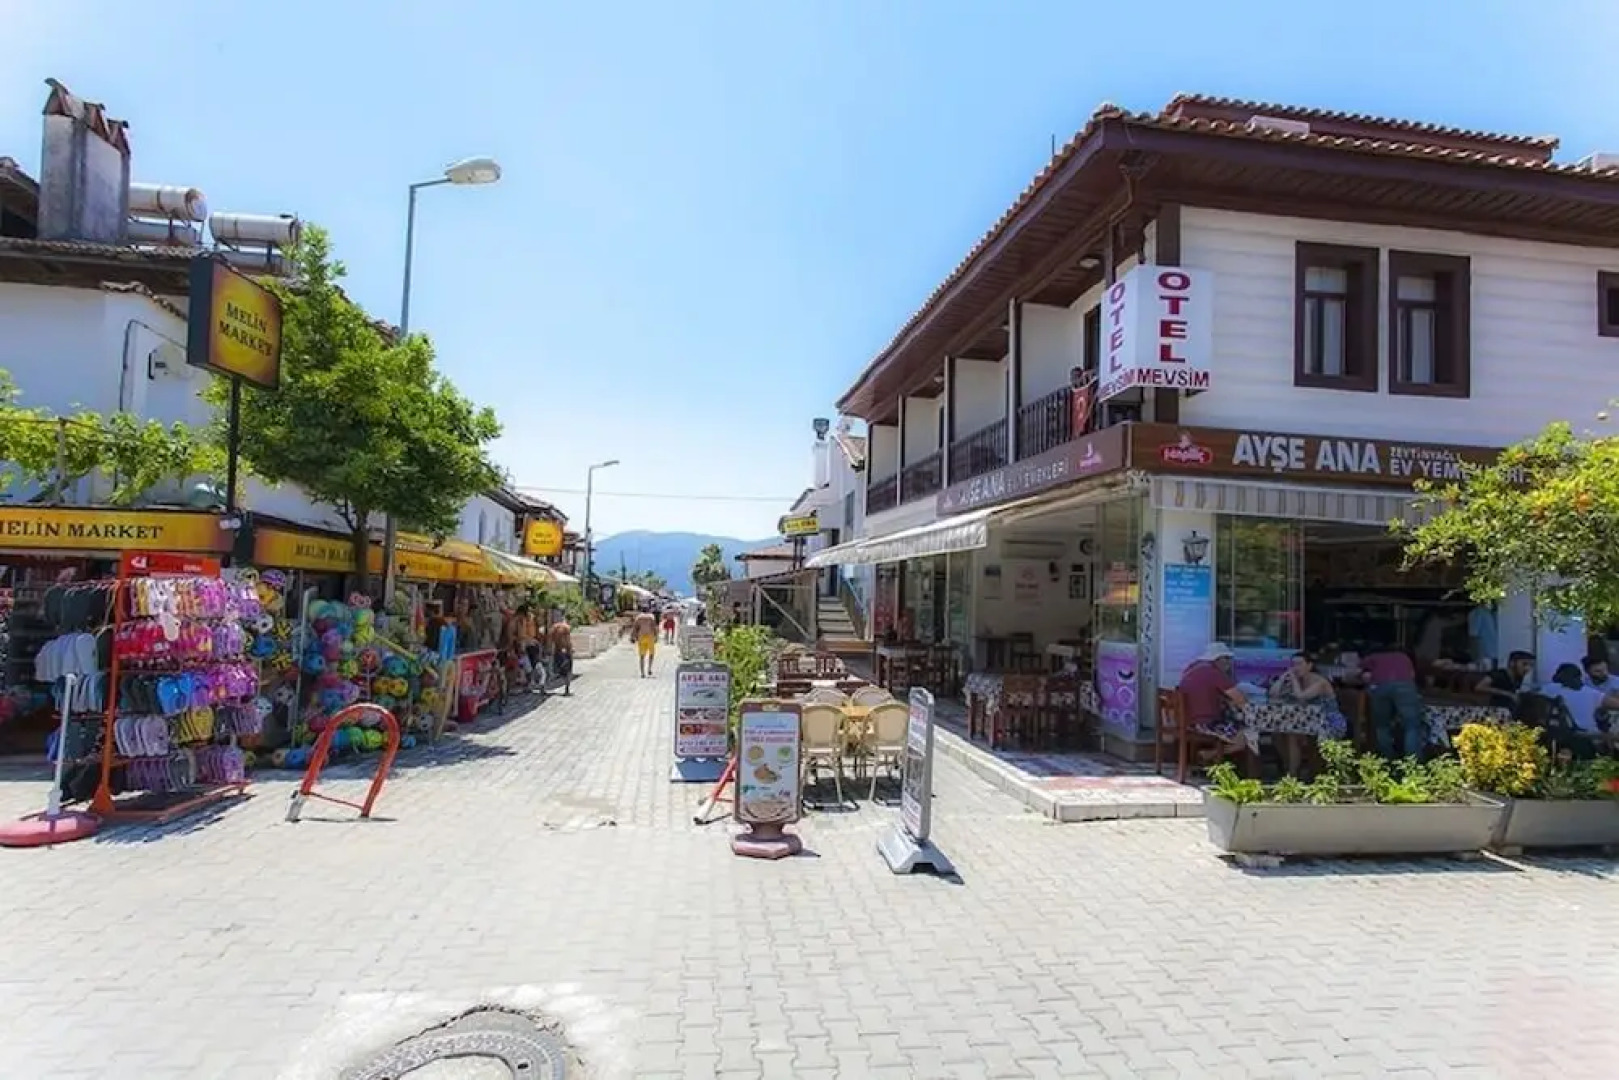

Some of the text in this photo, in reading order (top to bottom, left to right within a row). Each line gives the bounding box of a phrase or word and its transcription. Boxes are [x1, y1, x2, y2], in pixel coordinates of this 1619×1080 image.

[1110, 282, 1125, 373] OTEL
[1158, 271, 1191, 363] OTEL
[219, 320, 272, 356] MARKET
[1137, 368, 1210, 387] MEVSİM
[1232, 434, 1305, 473] AYŞE
[1315, 440, 1380, 474] ANA
[1390, 459, 1413, 476] EV
[67, 523, 163, 540] MARKET
